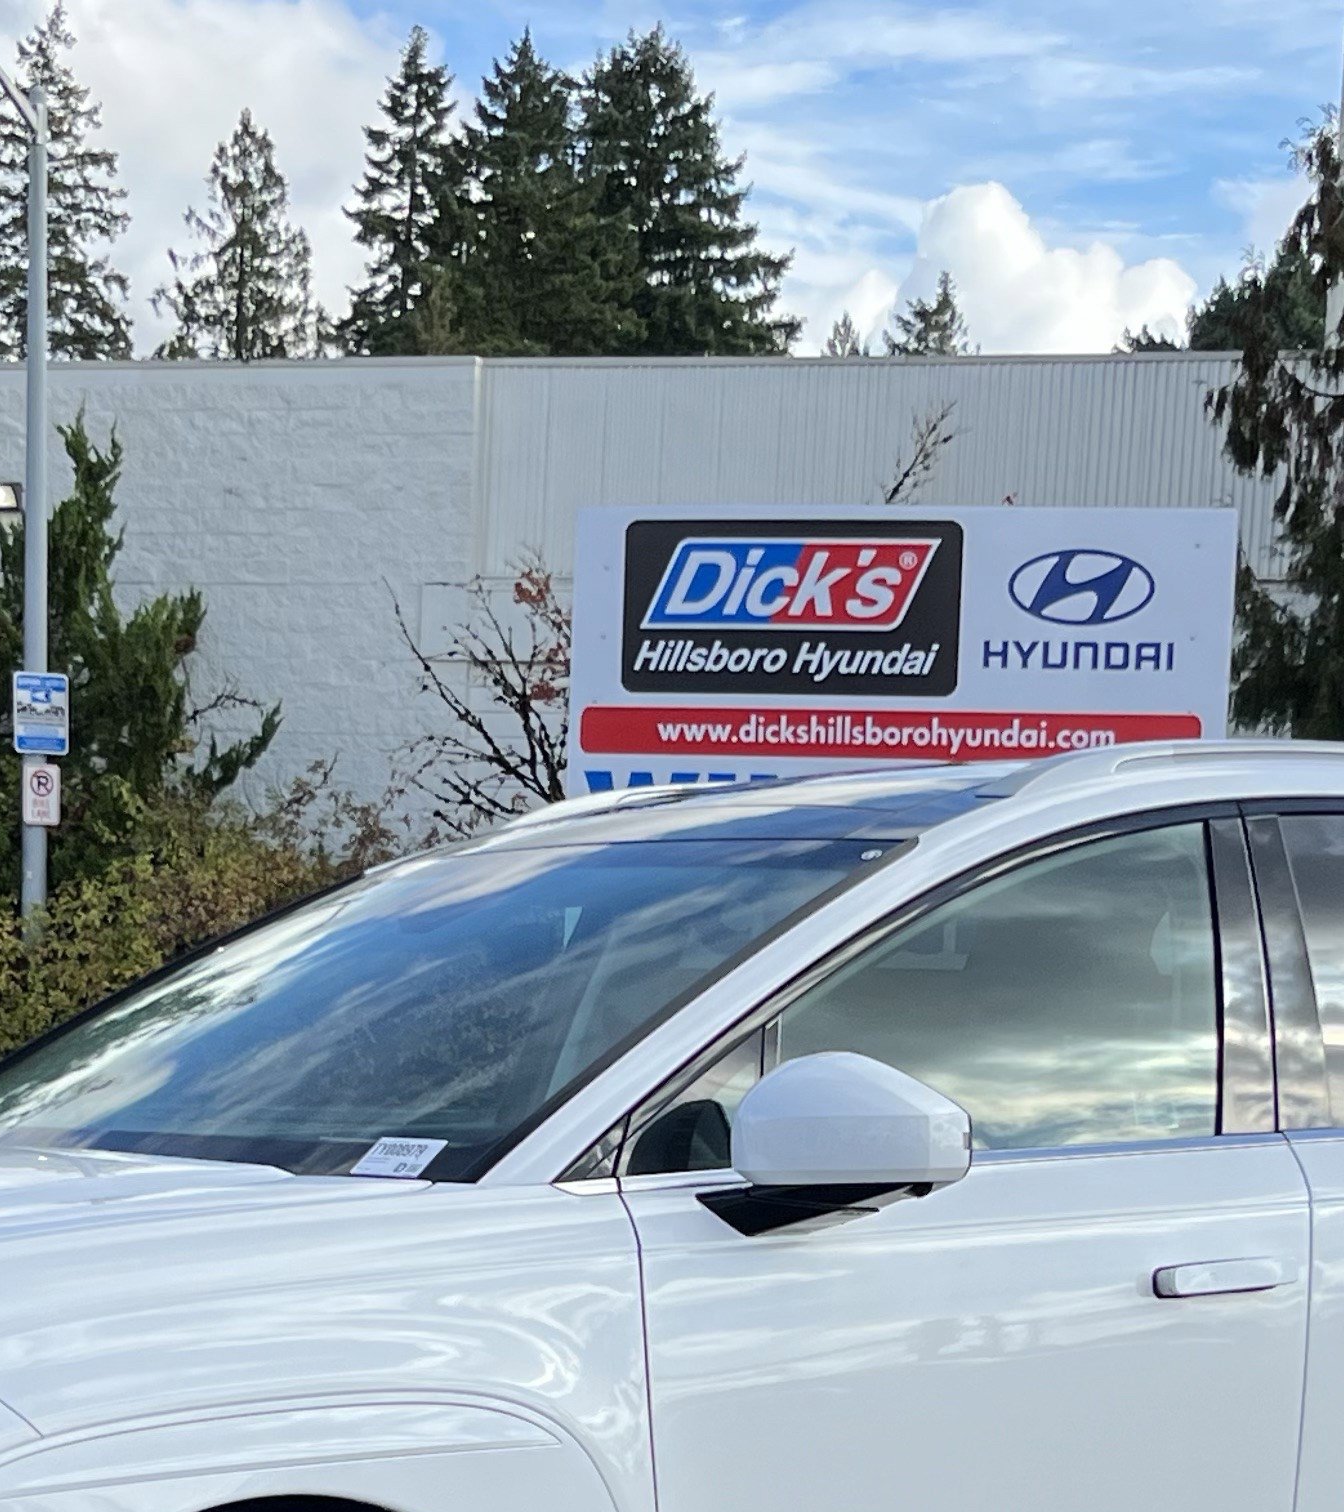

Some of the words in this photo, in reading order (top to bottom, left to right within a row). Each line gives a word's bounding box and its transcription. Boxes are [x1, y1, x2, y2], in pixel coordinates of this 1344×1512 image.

[664, 548, 901, 619] Dick's
[633, 639, 786, 675] Hillsboro
[792, 641, 939, 682] Hyundai
[982, 639, 1175, 671] HYUNDAI
[657, 715, 1116, 755] www.dickshillsborohyundai.com
